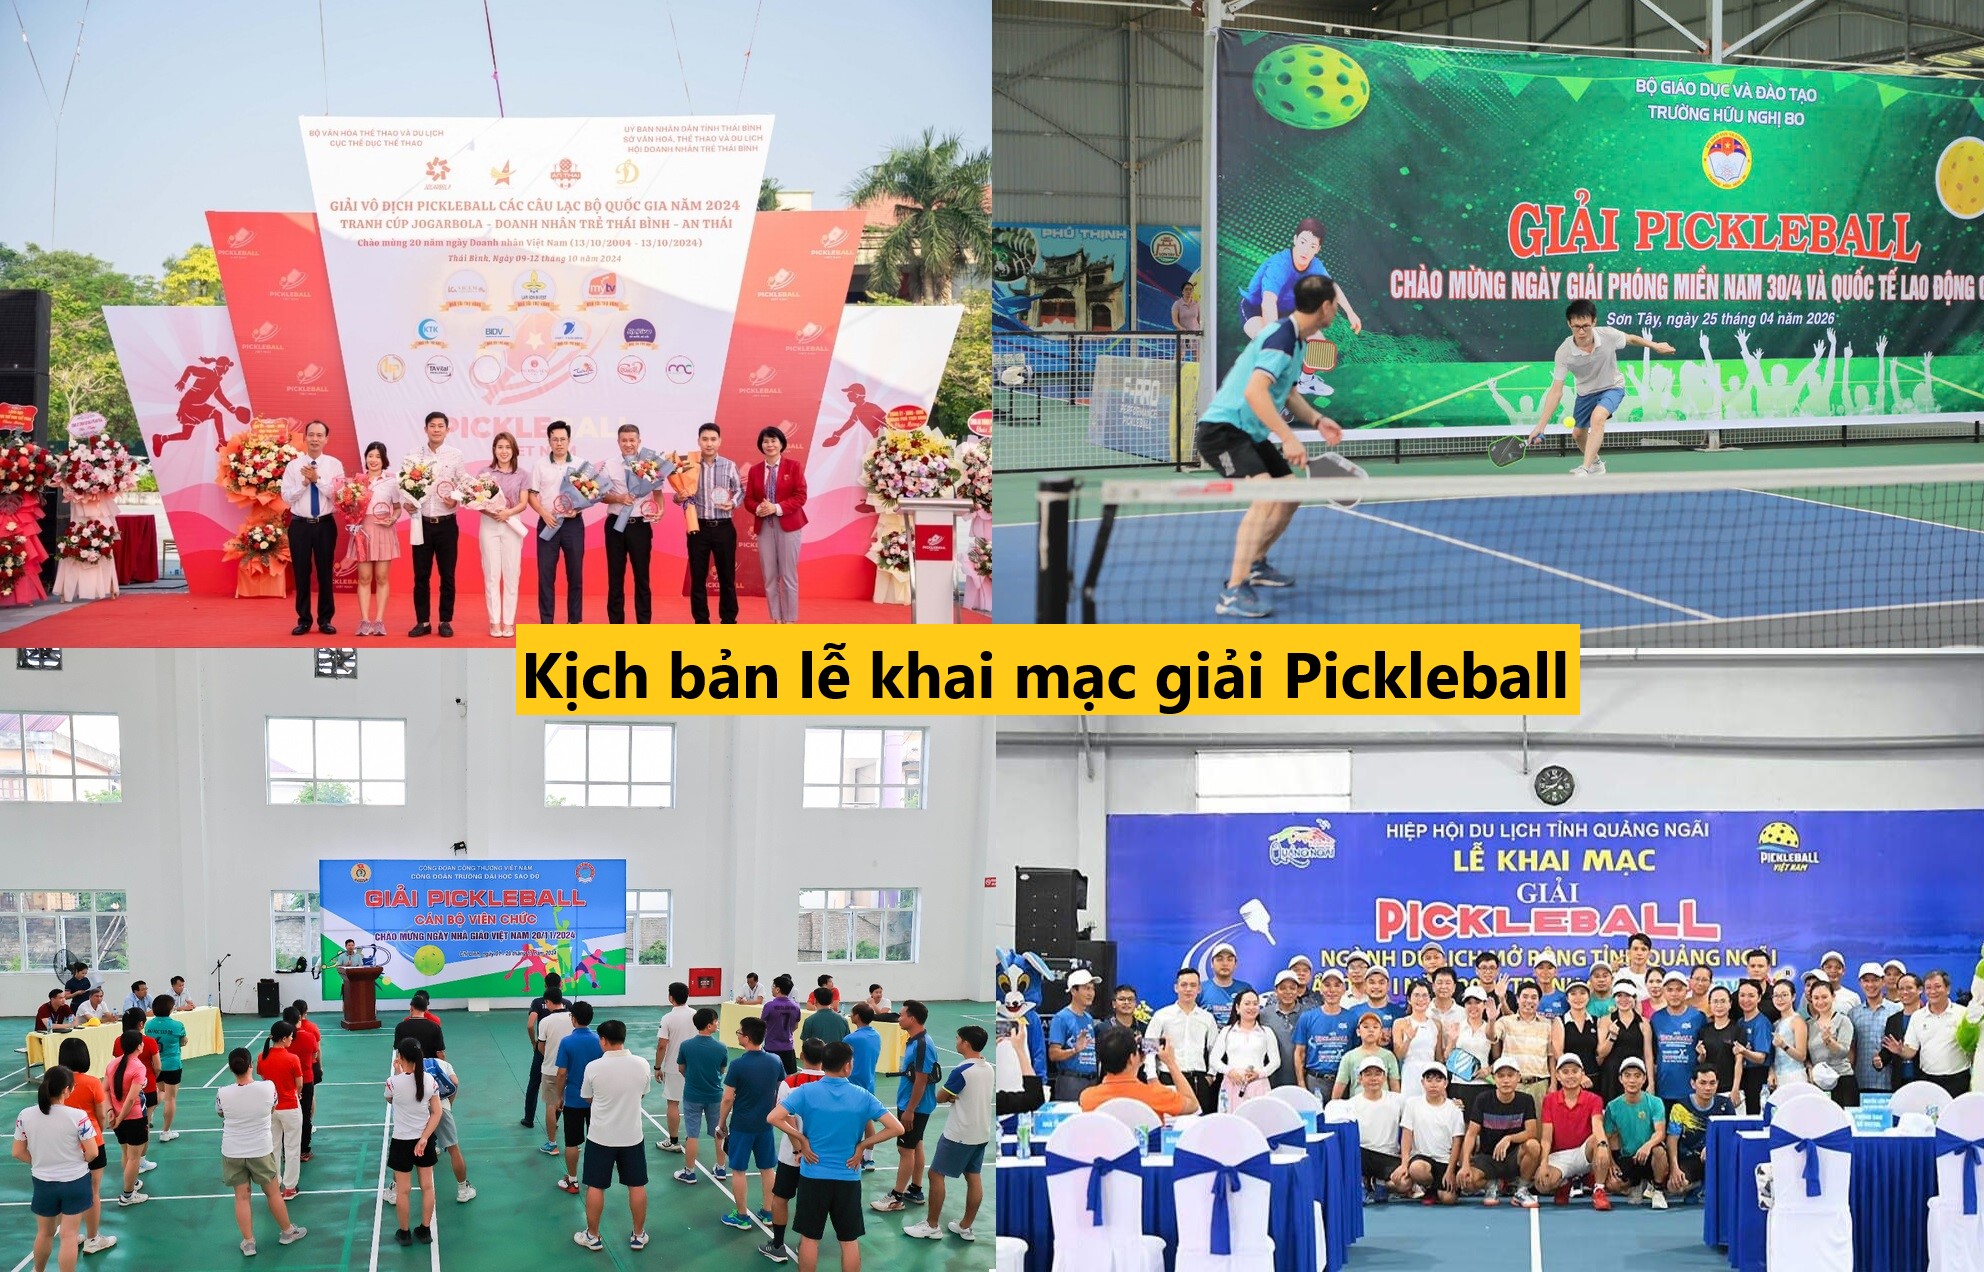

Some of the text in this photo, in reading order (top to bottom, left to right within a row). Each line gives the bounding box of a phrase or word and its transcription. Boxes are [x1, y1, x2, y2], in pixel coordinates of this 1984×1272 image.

[1636, 76, 1817, 105] BỘ GIÁO DỤC VÀ ĐÀO TẠO
[1648, 104, 1710, 122] TRƯỜNG
[1713, 105, 1744, 123] HỮU
[1748, 110, 1782, 128] NGHỊ
[330, 197, 740, 214] GIẢI VÔ ĐỊCH PICKLEBALL CÁC CÂU LẠC BỘ QUỐC GIA NĂM 2024
[340, 216, 732, 229] TRANH CÚP JOGARBOLA DOANH NHÂN TRẺ THÁI BÌNH AN THÁI
[1508, 188, 1922, 264] GIẢI PICKLEBALL
[1042, 226, 1127, 240] PHÚ THỊNH
[357, 238, 379, 247] Chào
[382, 239, 407, 248] mừng
[446, 239, 468, 248] ngày
[570, 239, 631, 248] (13/10/2004
[641, 239, 702, 248] 13/10/2024)
[493, 255, 514, 264] Ngày
[590, 283, 616, 295] mytv
[1390, 263, 1975, 306] CHÀO MỪNG NGÀY GIẢI PHÓNG MIỀN NAM 30/4 VÀ QUỐC TẾ LAO ĐỘNG
[1607, 312, 1835, 328] Sơn Tây, ngày 25 tháng 04 năm 2026
[448, 416, 628, 439] PICKLEAL
[1386, 820, 1709, 841] HIỆP HỘI DU LỊCH TỈNH QUẢNG NGÃI
[1454, 841, 1656, 876] LỄ KHAI MẠC
[1760, 852, 1820, 864] PICKLEBALL
[1790, 863, 1808, 872] NAM
[364, 884, 587, 908] GIẢI PICKLEBALL
[1516, 876, 1579, 904] GIẢI
[414, 912, 537, 928] CÁN BỘ VIÊN CHỨC
[1376, 898, 1721, 943] PICKLEBALL
[374, 931, 397, 941] CHÀO
[400, 930, 424, 941] MỪNG
[426, 931, 448, 941] NGÀY
[470, 930, 489, 940] GIÁO
[492, 930, 508, 942] VIỆT
[510, 931, 529, 940] NAM
[531, 931, 576, 940] 20/11/2024
[1321, 944, 1777, 968] NGNH MỞ RNG QUẢNG NGI
[780, 1012, 791, 1031] 7
